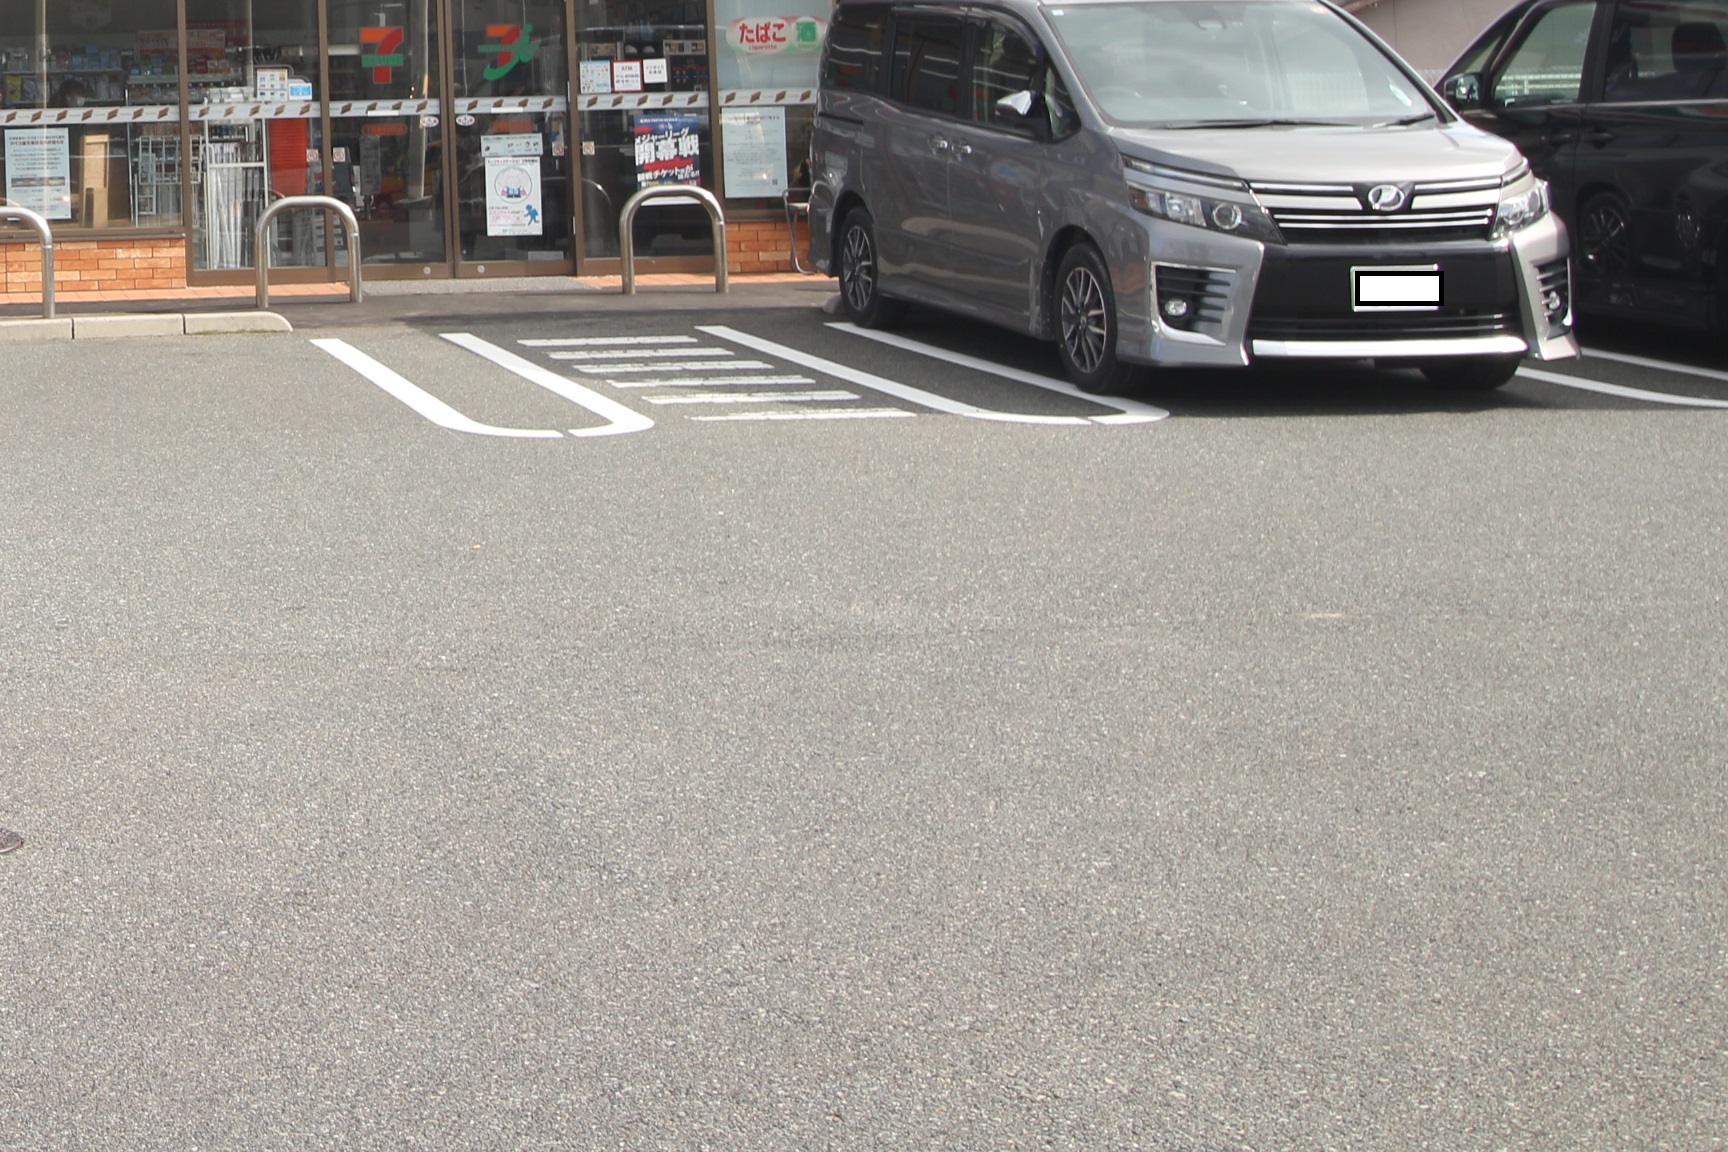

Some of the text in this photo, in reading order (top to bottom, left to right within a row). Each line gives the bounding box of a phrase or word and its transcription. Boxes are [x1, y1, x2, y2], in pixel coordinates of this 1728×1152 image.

[738, 22, 787, 44] たばこ
[634, 134, 700, 167] 開幕戦
